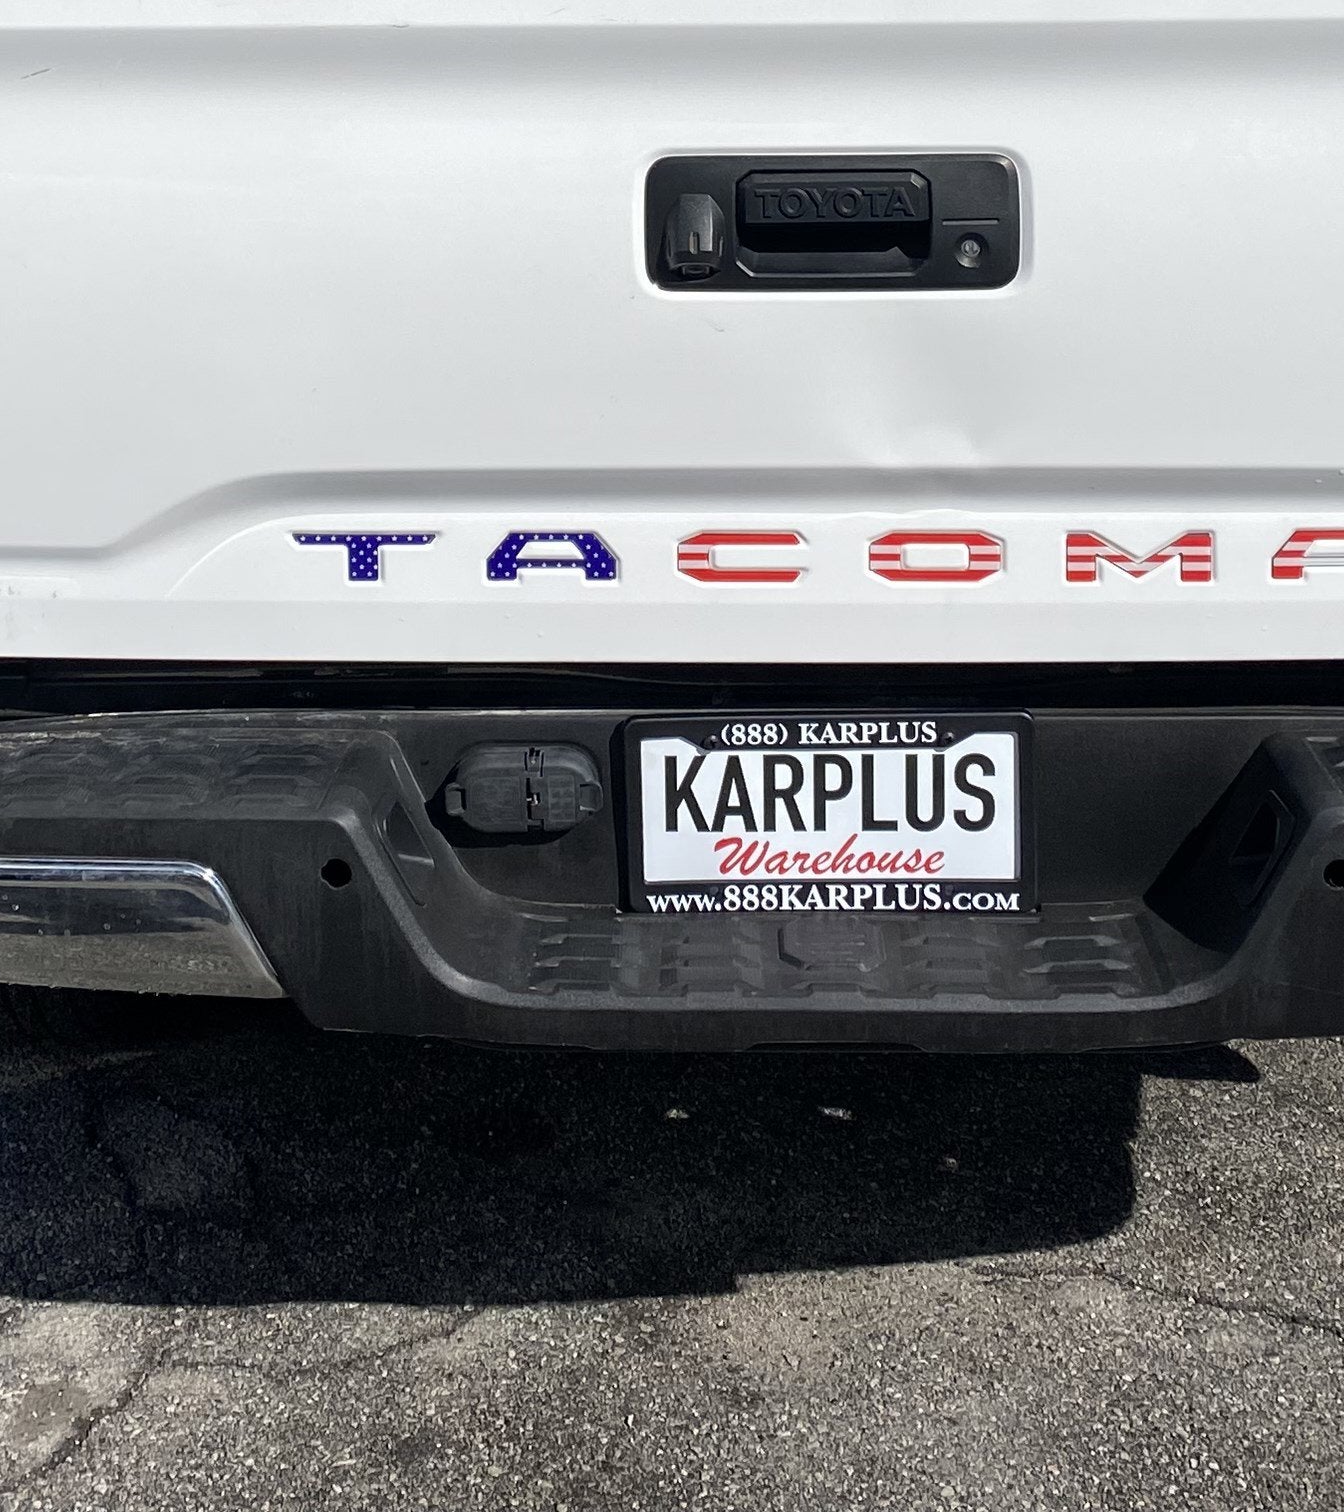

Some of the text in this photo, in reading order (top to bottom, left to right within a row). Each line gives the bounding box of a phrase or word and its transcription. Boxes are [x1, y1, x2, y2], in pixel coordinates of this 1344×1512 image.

[755, 188, 915, 220] TOYOTA
[720, 721, 937, 746] (888) KARPLUS
[664, 753, 996, 833] KARPLUS
[714, 833, 945, 876] Warehouse
